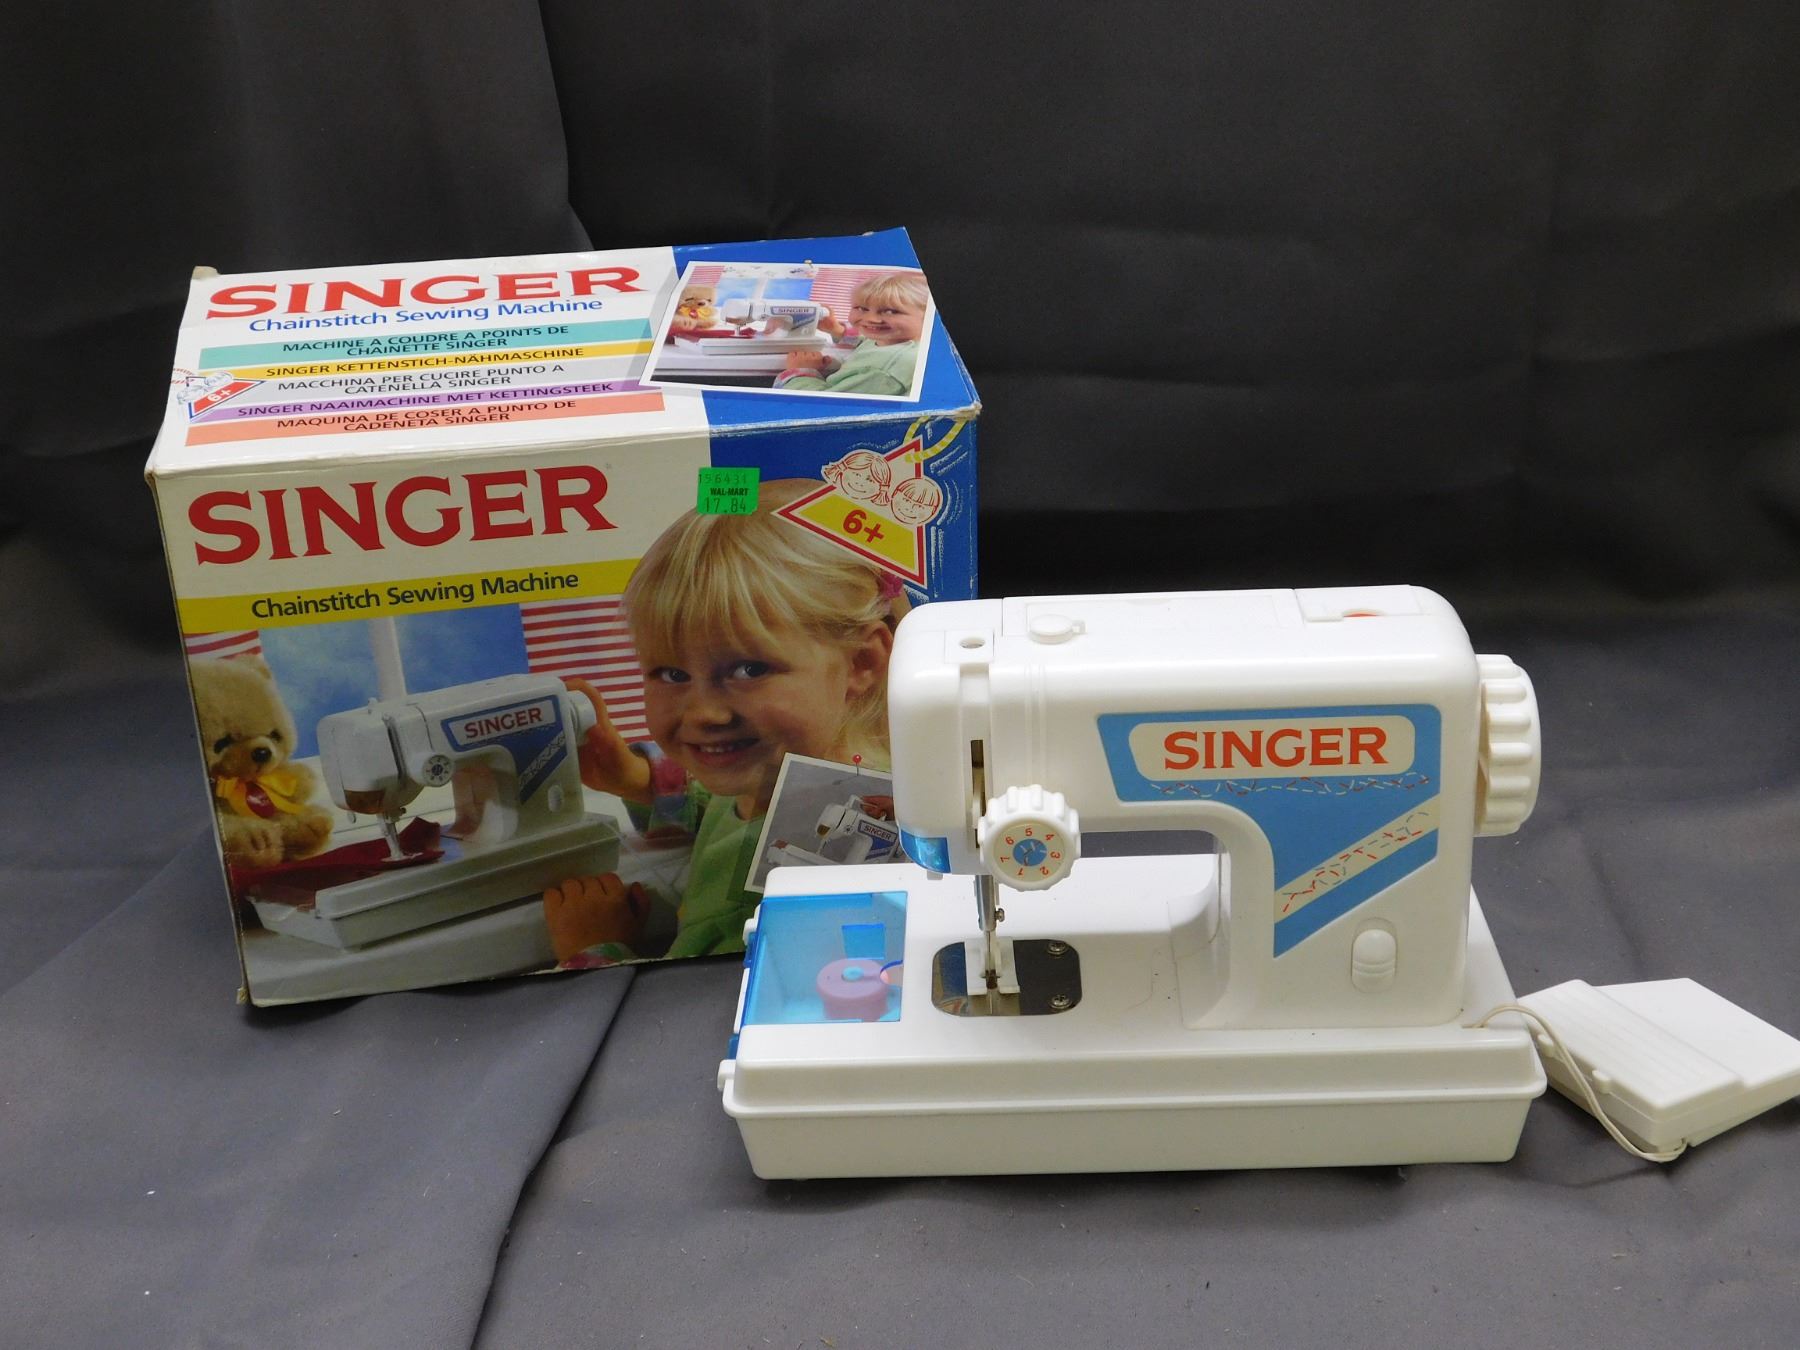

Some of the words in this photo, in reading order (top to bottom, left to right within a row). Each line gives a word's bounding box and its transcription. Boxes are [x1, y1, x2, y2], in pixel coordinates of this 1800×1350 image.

[206, 266, 648, 320] SINGER
[249, 312, 387, 332] Chainstitch
[396, 306, 489, 323] Sewing
[498, 299, 603, 316] Machine
[283, 339, 364, 352] MACHINE
[370, 338, 383, 347] A
[388, 333, 458, 345] COUDRE
[464, 332, 477, 340] A
[482, 327, 542, 339] POINTS
[548, 325, 569, 334] DE
[347, 342, 440, 356] CHAINETTE
[446, 338, 508, 350] SINGER
[266, 365, 329, 377] SINGER
[336, 348, 584, 372] KETTENSTICH-NÄHMASCHINE
[278, 377, 375, 391] MACCHINA
[382, 375, 413, 384] PER
[420, 367, 481, 381] CUCIRE
[487, 365, 546, 376] PUNTO
[552, 364, 565, 372] A
[345, 381, 442, 394] CATENELLA
[448, 377, 512, 388] SINGER
[238, 404, 303, 417] SINGER
[310, 395, 441, 411] NAAIMACHINE
[447, 392, 485, 402] MET
[490, 383, 613, 400] KETTINGSTEEK
[277, 414, 369, 428] MAQUINA
[376, 412, 399, 421] DE
[404, 408, 462, 419] COSER
[468, 407, 481, 415] A
[487, 402, 548, 413] PUNTO
[554, 400, 577, 409] DE
[344, 418, 438, 431] CADENETA
[445, 413, 511, 425] SINGER
[710, 487, 748, 496] WAL-MART
[187, 465, 618, 566] SINGER
[842, 509, 885, 544] 6+
[251, 588, 381, 620] Chainstitch
[388, 581, 475, 606] Sewing
[481, 571, 580, 596] Machine
[463, 707, 544, 739] SINGER
[1163, 726, 1389, 770] SINGER
[863, 824, 893, 841] SINGER
